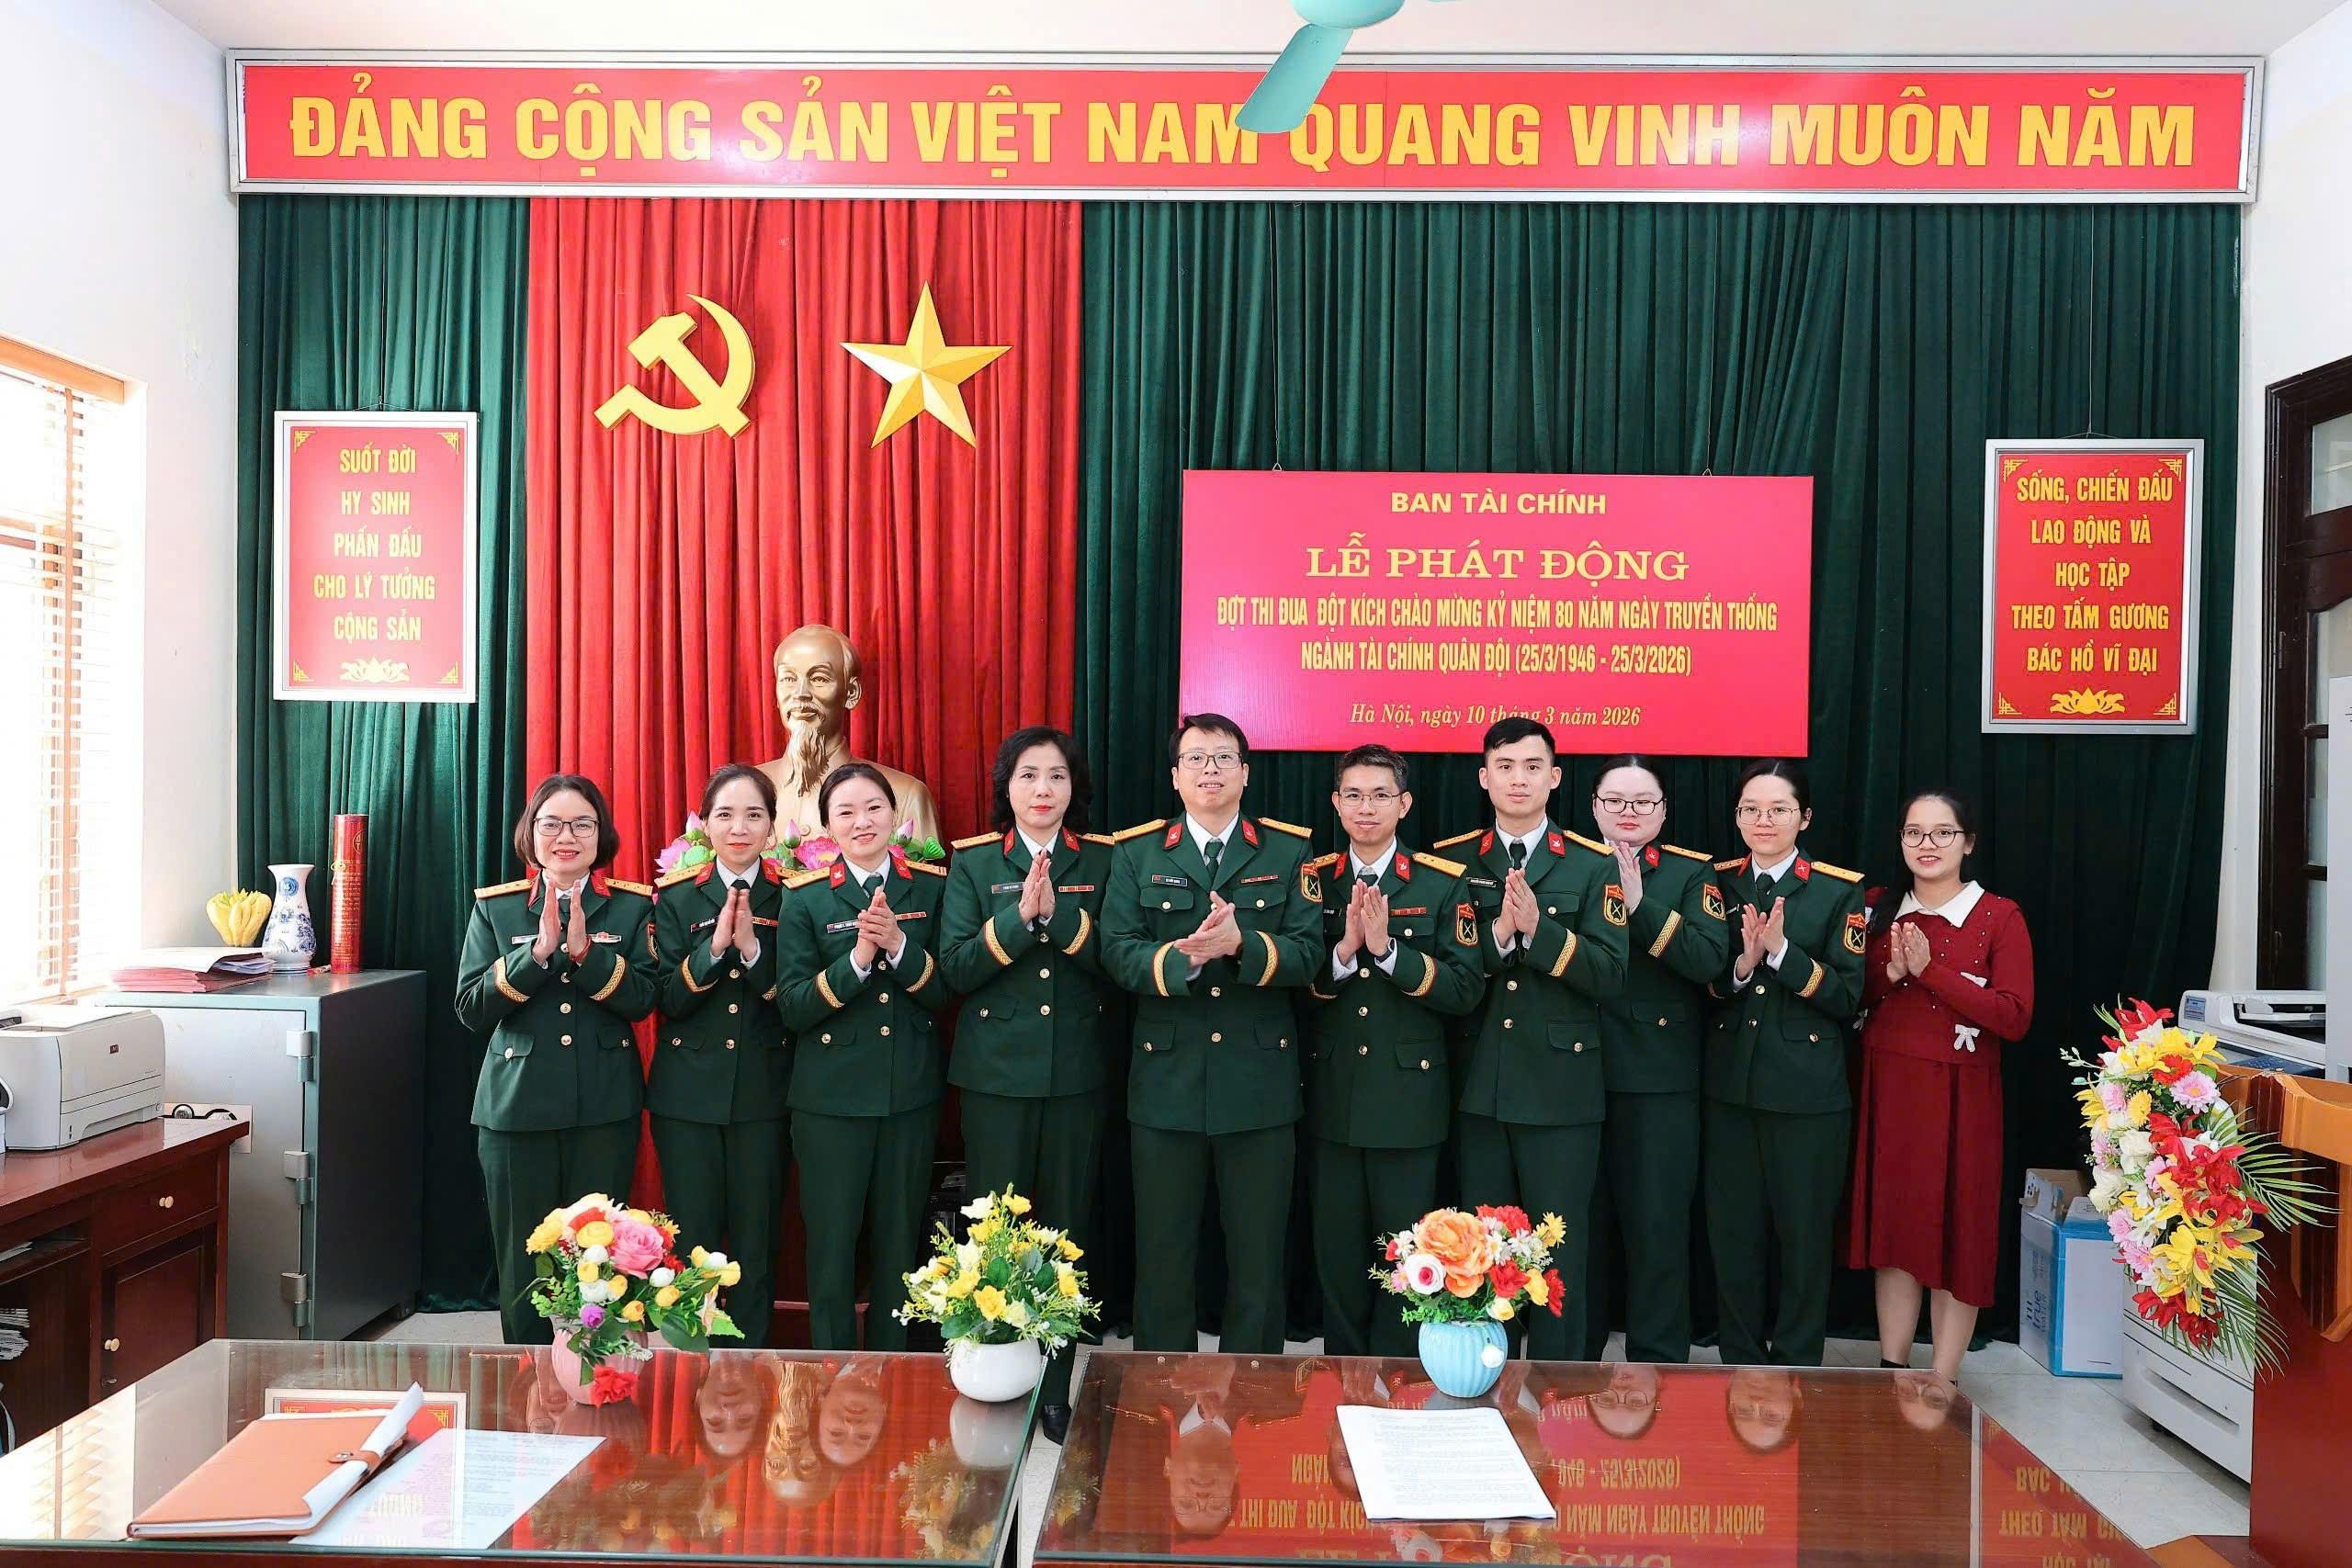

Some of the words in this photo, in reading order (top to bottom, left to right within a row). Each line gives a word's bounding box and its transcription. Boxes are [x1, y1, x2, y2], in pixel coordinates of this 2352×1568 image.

[290, 73, 487, 160] ĐẢNG
[516, 85, 711, 177] CỘNG
[739, 75, 888, 162] SẢN
[911, 85, 1060, 177] VIỆT
[1087, 101, 1259, 164] NAM
[1290, 103, 1540, 172] QUANG
[1569, 105, 1736, 165] VINH
[1768, 86, 1989, 166] MUÔN
[2018, 89, 2194, 167] NĂM
[339, 442, 380, 473] SUỐT
[388, 443, 415, 473] ĐỜI
[341, 491, 361, 515] HY
[370, 491, 410, 515] SINH
[1391, 492, 1451, 513] BAN
[1461, 488, 1507, 513] TÀI
[1517, 489, 1607, 514] CHÍNH
[2017, 468, 2069, 503] SỐNG,
[2076, 468, 2129, 501] CHIẾN
[2138, 468, 2173, 502] ĐẤU
[334, 525, 379, 558] PHẤN
[389, 525, 422, 558] ĐẤU
[2030, 519, 2064, 544] LAO
[2073, 514, 2120, 549] ĐỘNG
[2130, 514, 2151, 544] VÀ
[1306, 532, 1370, 577] LỄ
[1385, 539, 1523, 579] PHÁT
[1539, 540, 1690, 588] ĐỘNG
[2055, 562, 2090, 591] HỌC
[2098, 557, 2131, 591] TẬP
[313, 574, 345, 598] CHO
[355, 571, 372, 598] LÝ
[380, 567, 435, 600] TƯỞNG
[334, 612, 378, 646] CỘNG
[387, 609, 422, 641] SẢN
[1217, 594, 1246, 631] ĐỢT
[1251, 597, 1273, 625] THI
[1278, 598, 1308, 626] ĐUA
[1317, 592, 1346, 632] ĐỘT
[1351, 592, 1386, 626] KÍCH
[1390, 592, 1431, 626] CHÀO
[1436, 593, 1483, 627] MỪNG
[1487, 590, 1506, 626] KỶ
[1510, 593, 1551, 634] NIỆM
[1555, 601, 1574, 628] 80
[1578, 594, 1614, 629] NĂM
[1618, 595, 1659, 630] NGÀY
[1664, 592, 1723, 630] TRUYỀN
[1727, 592, 1778, 631] THỐNG
[2011, 605, 2055, 629] THEO
[2063, 597, 2099, 629] TẤM
[2109, 603, 2169, 629] GƯƠNG
[1301, 636, 1353, 670] NGÀNH
[1359, 636, 1382, 671] TÀI
[1386, 636, 1434, 671] CHÍNH
[1439, 637, 1480, 674] QUÂN
[1485, 637, 1510, 677] ĐỘI
[1515, 643, 1597, 675] (25/3/1946
[1600, 656, 1607, 664] -
[1611, 645, 1692, 677] 25/3/2026)
[2028, 642, 2063, 672] BÁC
[2070, 639, 2095, 671] HỒ
[2103, 642, 2121, 671] VĨ
[2128, 647, 2158, 676] ĐẠI
[1350, 704, 1375, 724] Hà
[1382, 704, 1415, 729] Nội,
[1420, 707, 1462, 732] ngày
[1467, 705, 1487, 725] 10
[1544, 705, 1555, 725] 3
[1560, 709, 1598, 726] năm
[1601, 705, 1642, 727] 2026
[2033, 1291, 2042, 1329] true
